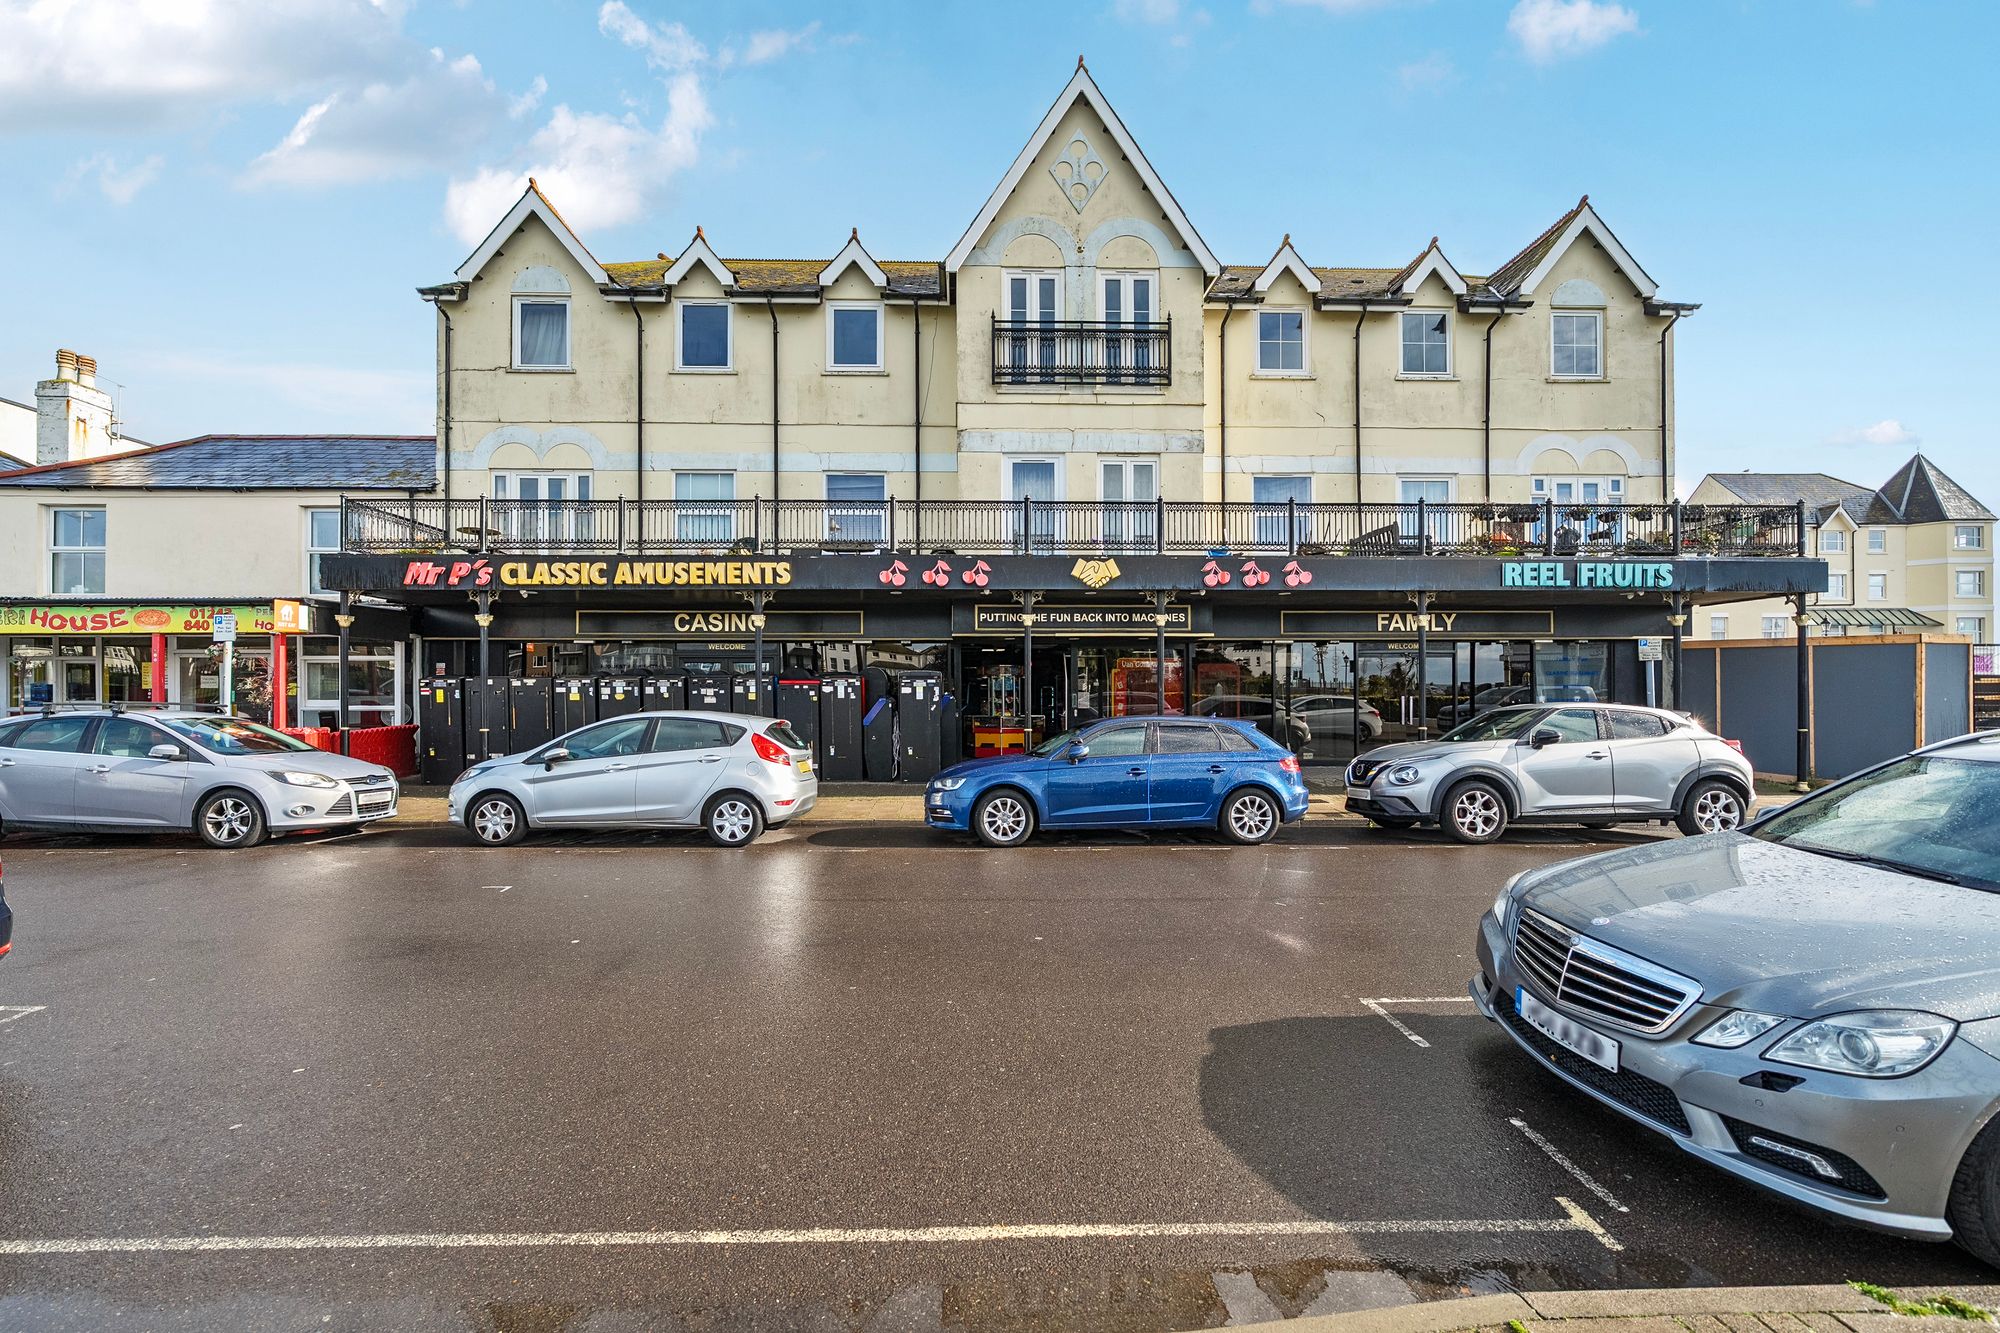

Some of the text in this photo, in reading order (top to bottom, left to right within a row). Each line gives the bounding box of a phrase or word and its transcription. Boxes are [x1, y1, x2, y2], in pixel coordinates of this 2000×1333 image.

[403, 560, 791, 586] Mr P's CLASSIC AMUSEMENTS
[1501, 562, 1673, 588] REEL FRUITS
[30, 608, 129, 631] HOUSE
[183, 619, 210, 631] 840
[674, 613, 765, 632] CASINO
[980, 613, 1186, 622] PUTTING HE FUN BACK INTO MACNES
